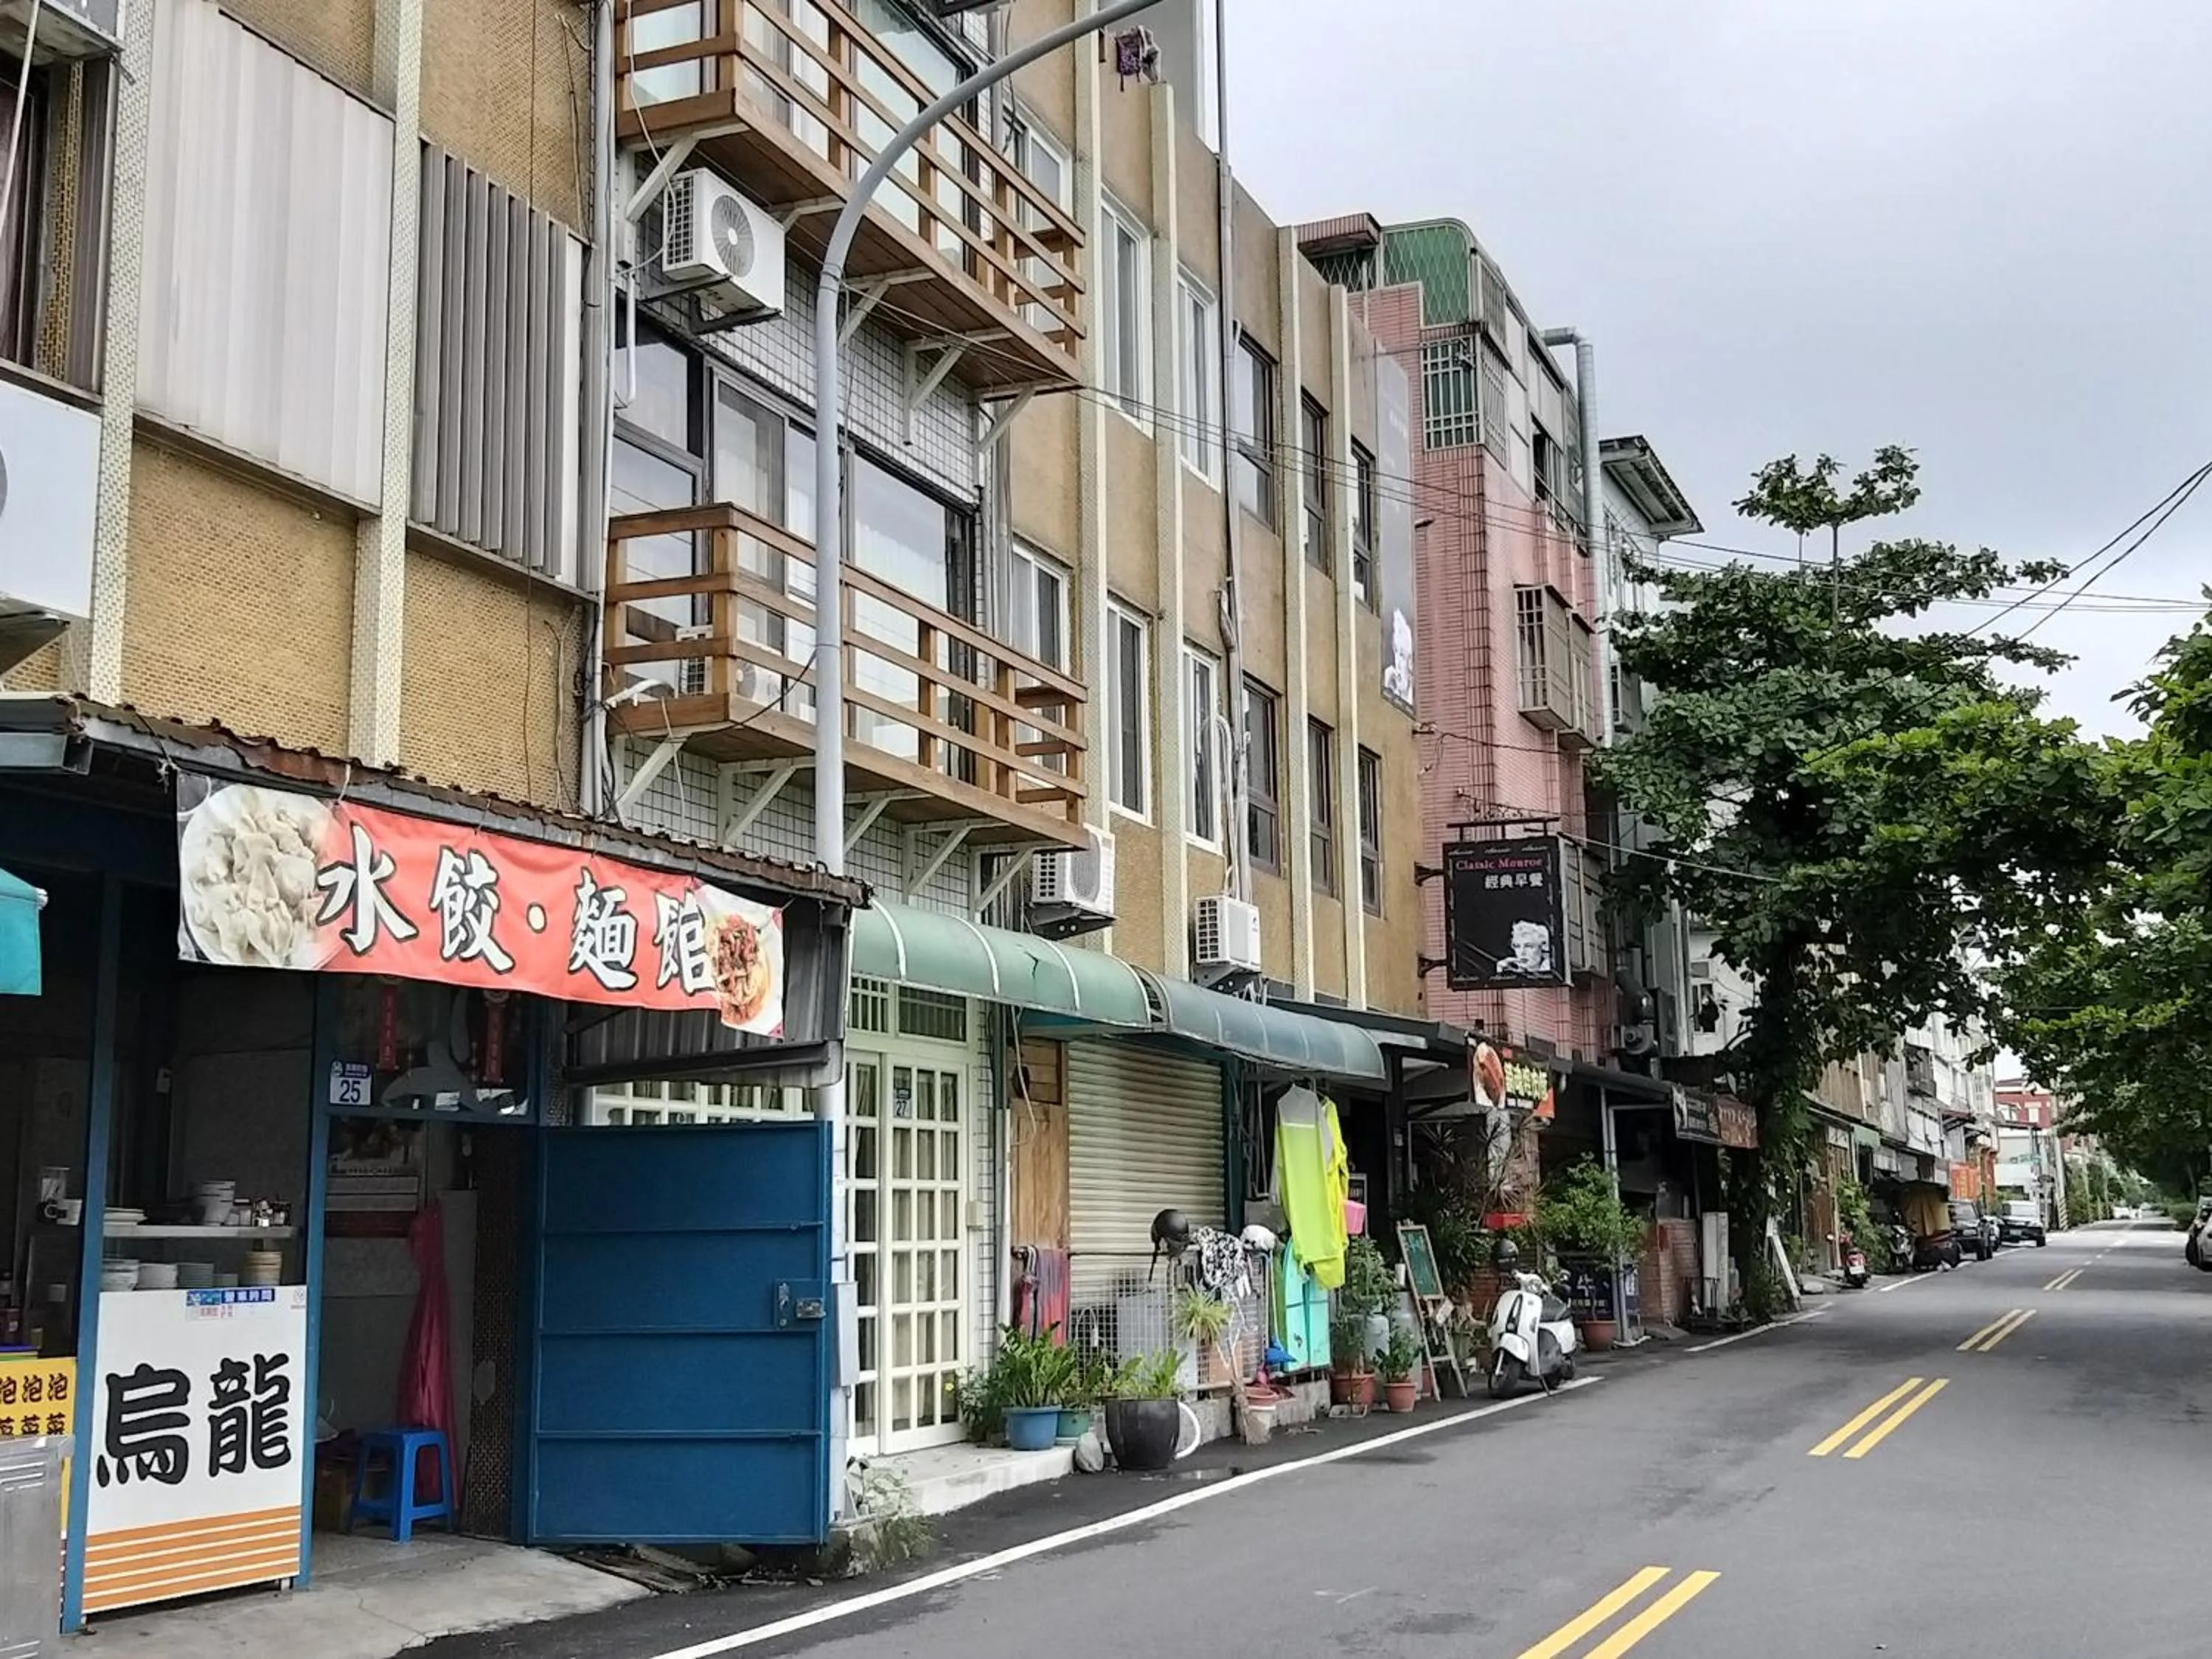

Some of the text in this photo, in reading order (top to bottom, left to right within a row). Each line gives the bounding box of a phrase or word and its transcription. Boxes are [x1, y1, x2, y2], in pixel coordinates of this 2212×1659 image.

[1455, 861, 1495, 870] Classic
[1484, 872, 1543, 889] 經典早餐
[339, 1079, 361, 1104] 25
[896, 1099, 908, 1118] 27
[97, 1353, 292, 1488] 烏龍
